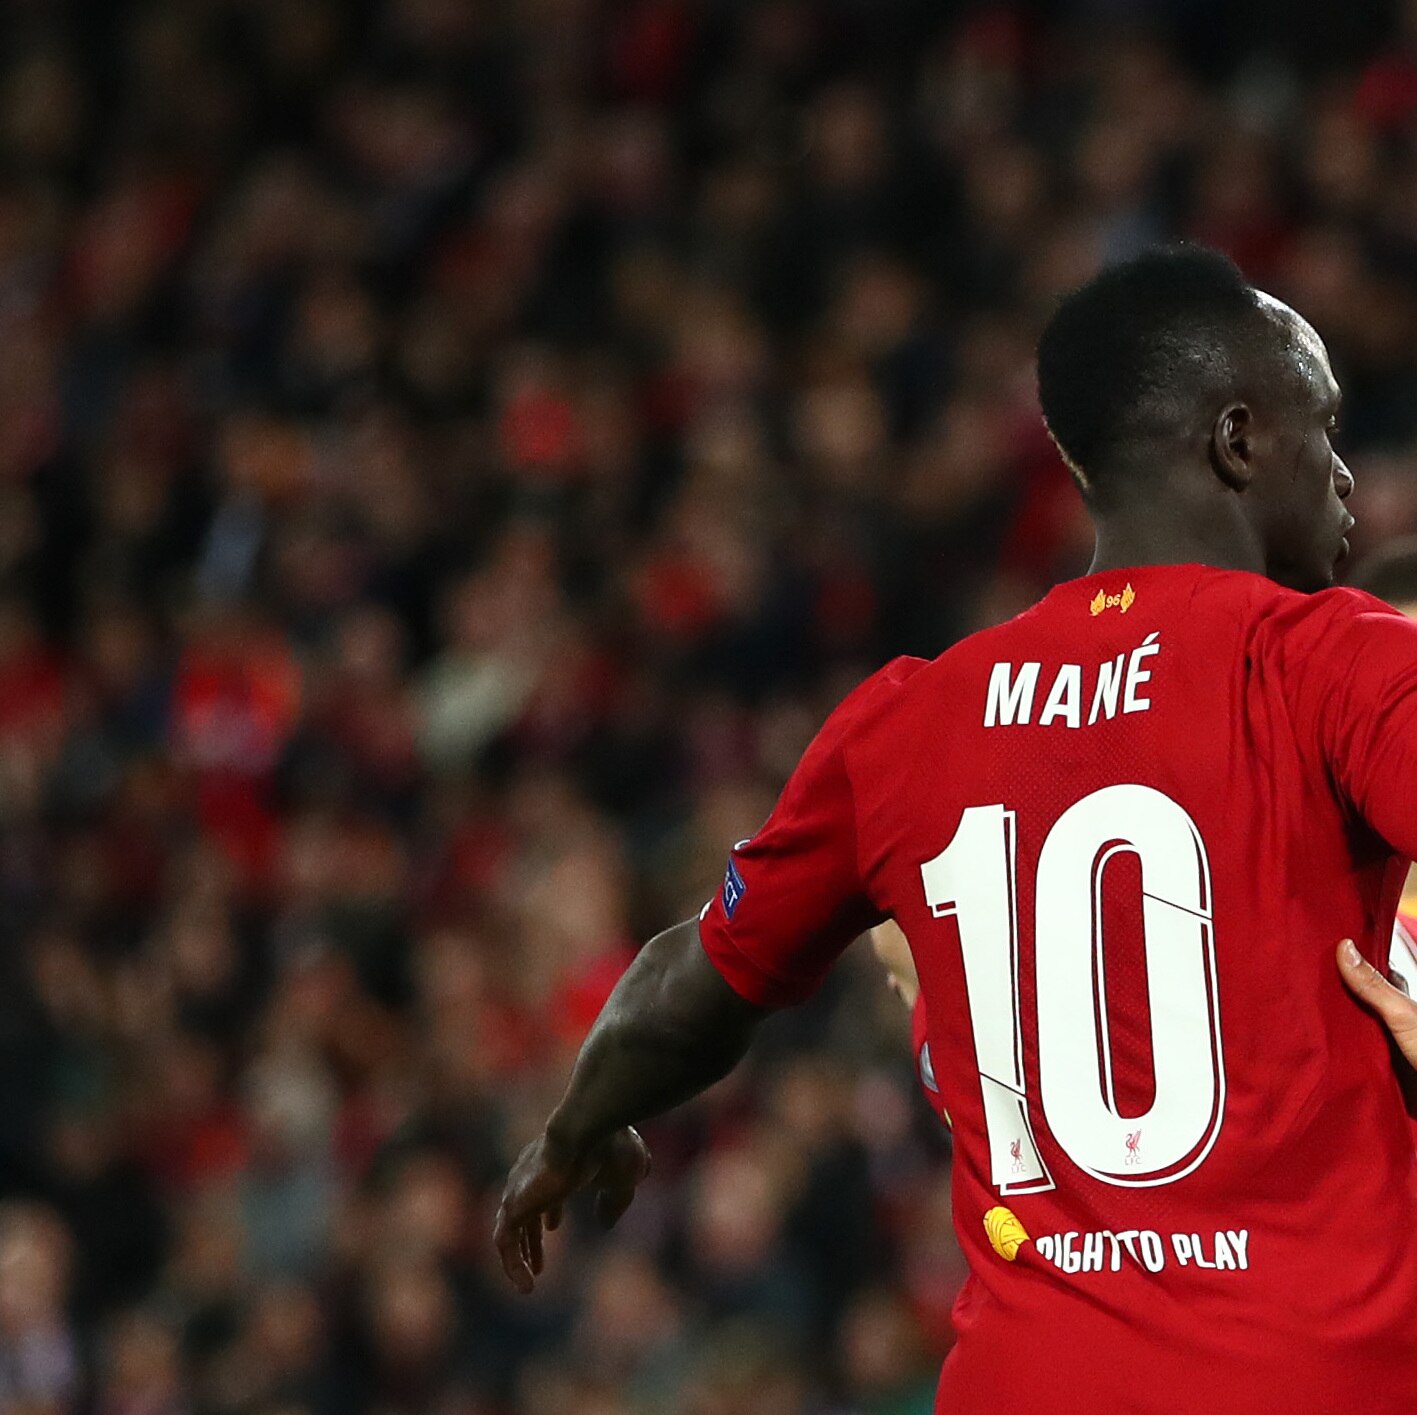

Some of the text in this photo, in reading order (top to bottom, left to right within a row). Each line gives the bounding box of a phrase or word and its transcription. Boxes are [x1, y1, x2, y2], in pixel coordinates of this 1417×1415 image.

[984, 631, 1160, 729] MANÉ
[921, 784, 1226, 1196] 10
[1171, 1229, 1249, 1270] PLAY
